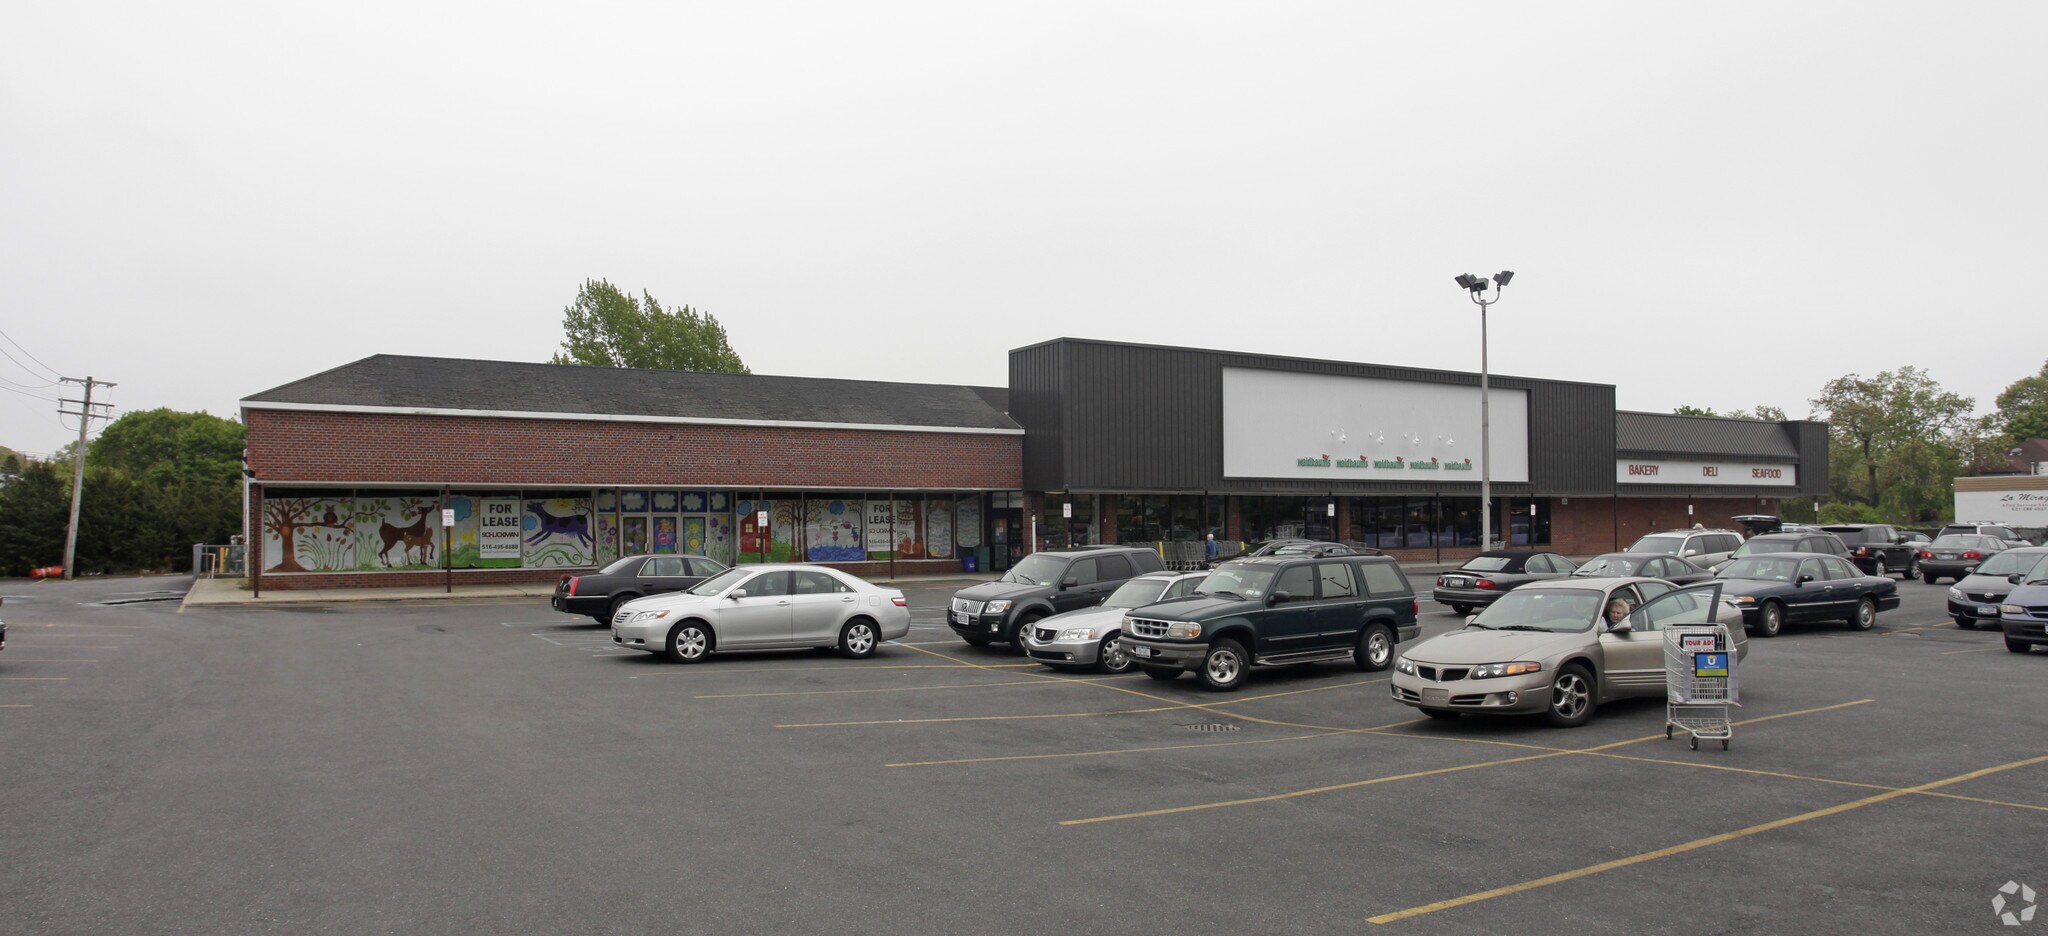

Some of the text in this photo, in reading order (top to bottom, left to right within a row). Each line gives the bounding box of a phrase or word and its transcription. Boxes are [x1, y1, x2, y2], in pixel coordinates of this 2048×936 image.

[1629, 464, 1781, 478] BAKERY DELI SEAFOOD
[489, 504, 512, 513] FOR
[874, 504, 891, 513] FOR
[482, 517, 519, 527] LEASE
[869, 516, 896, 524] LEASE
